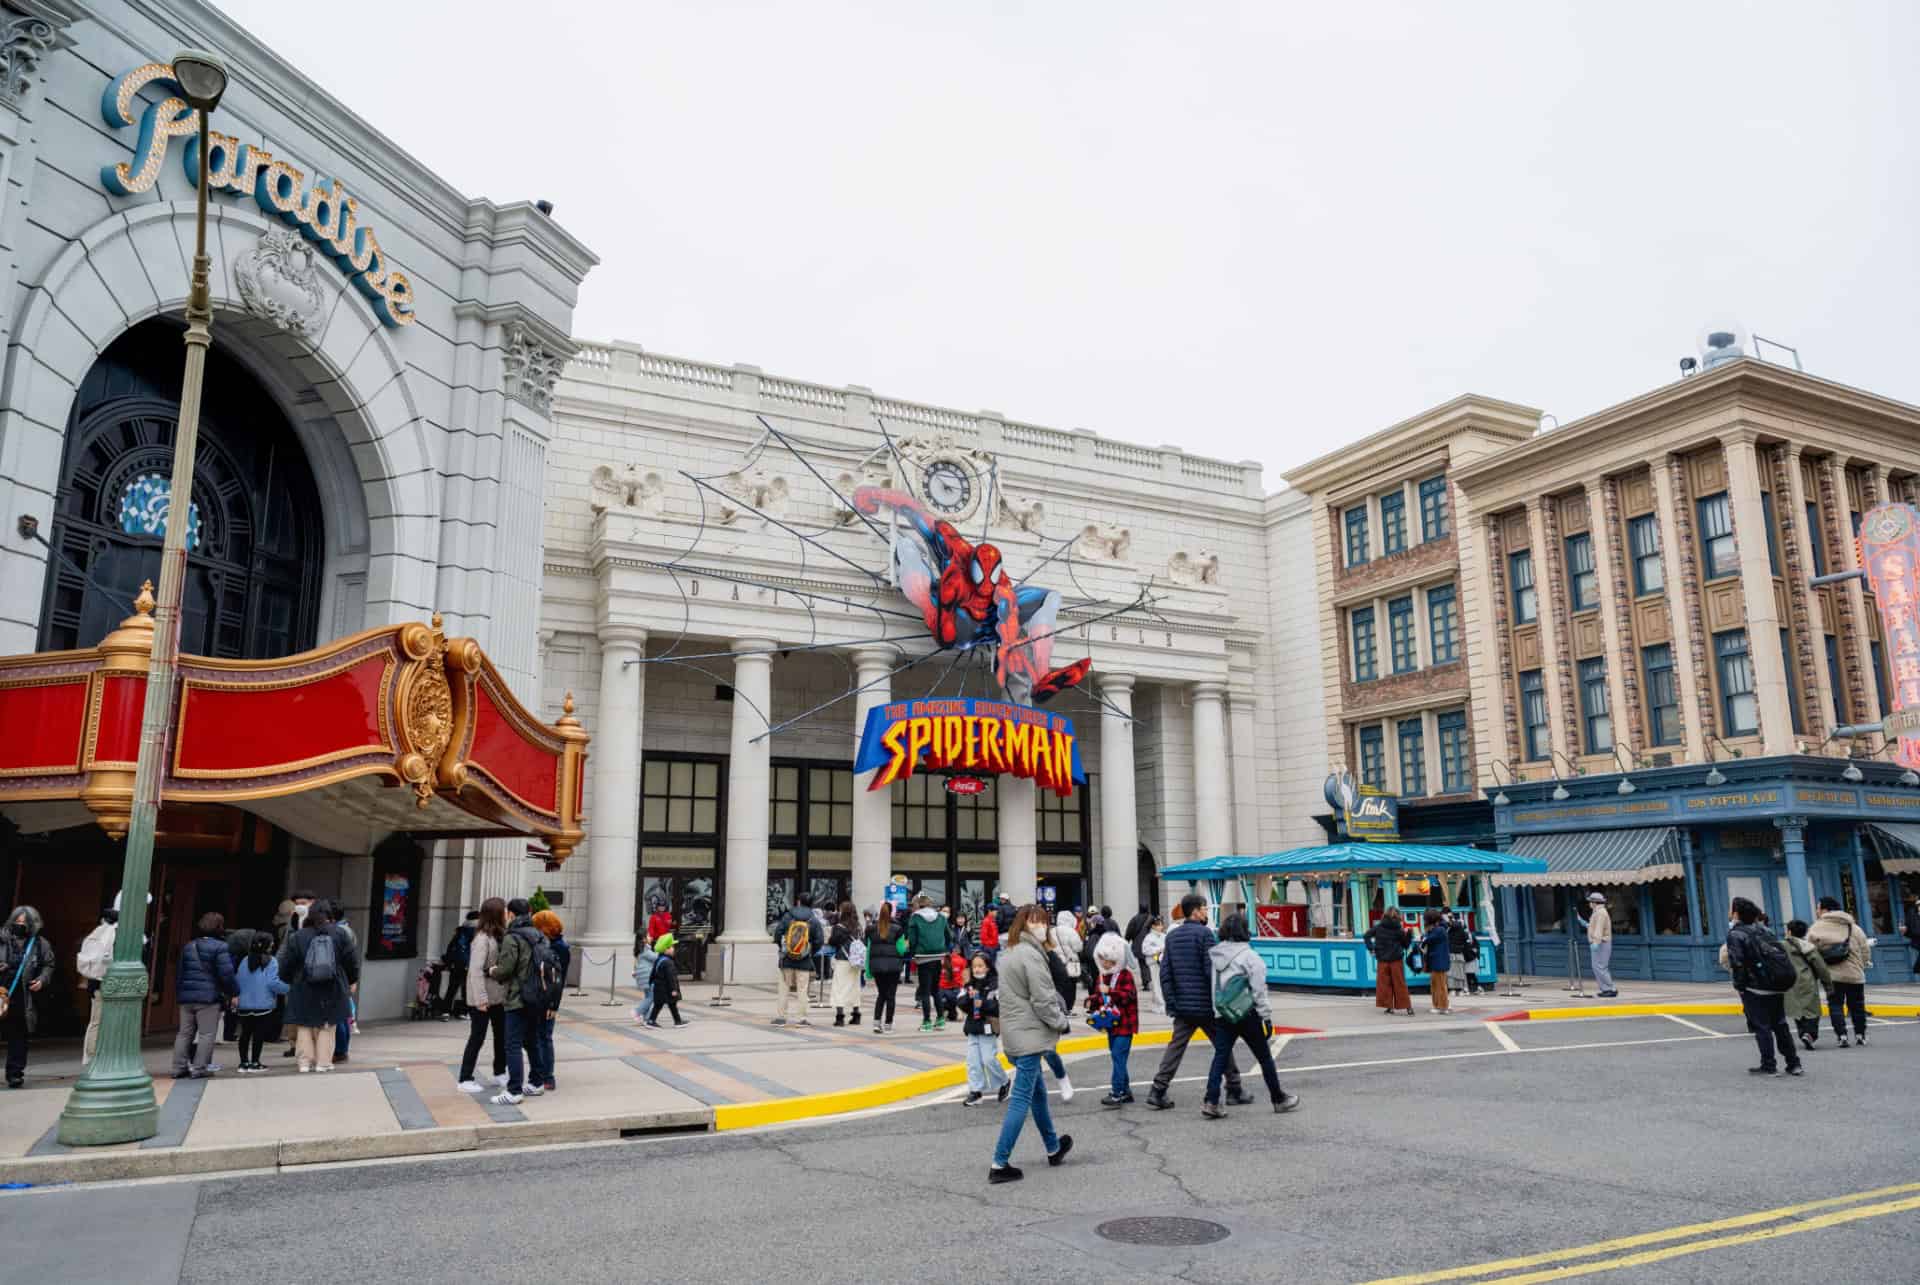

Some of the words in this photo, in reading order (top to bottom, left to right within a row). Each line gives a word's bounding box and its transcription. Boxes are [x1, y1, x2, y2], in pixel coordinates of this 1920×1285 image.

[101, 63, 417, 328] Paradise
[877, 714, 1075, 793] SPIDER-MAN
[884, 704, 908, 721] THE
[912, 701, 967, 715] AMAZING
[975, 702, 1048, 722] ADVENTURES
[1051, 716, 1067, 732] OF
